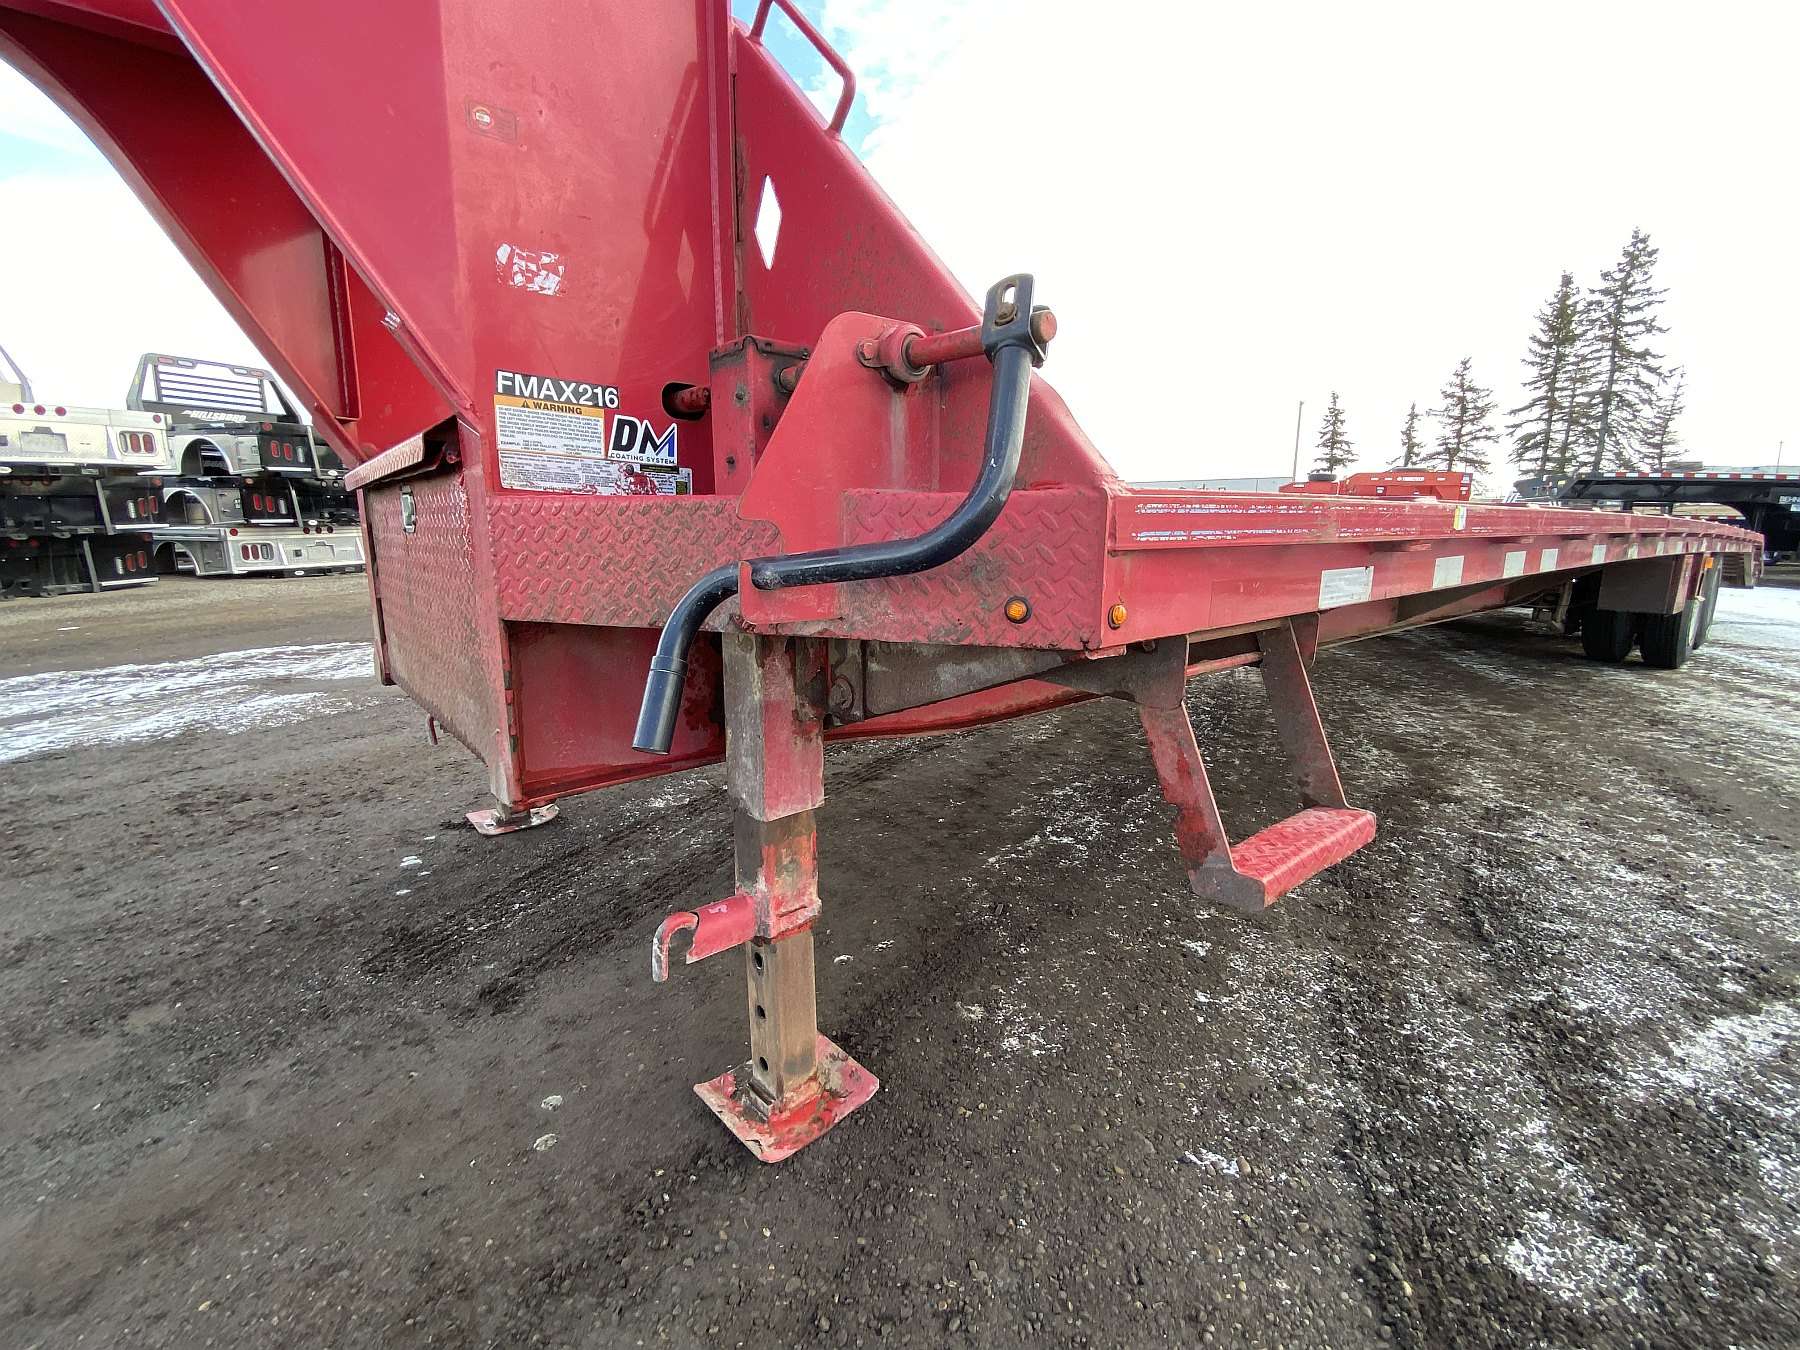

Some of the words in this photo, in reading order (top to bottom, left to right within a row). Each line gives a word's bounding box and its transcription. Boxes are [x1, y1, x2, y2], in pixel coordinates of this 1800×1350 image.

[497, 371, 619, 409] FMAX216
[533, 401, 583, 415] WARNING
[612, 418, 675, 457] DM
[610, 453, 644, 462] COATING
[646, 456, 675, 464] SYSTEM
